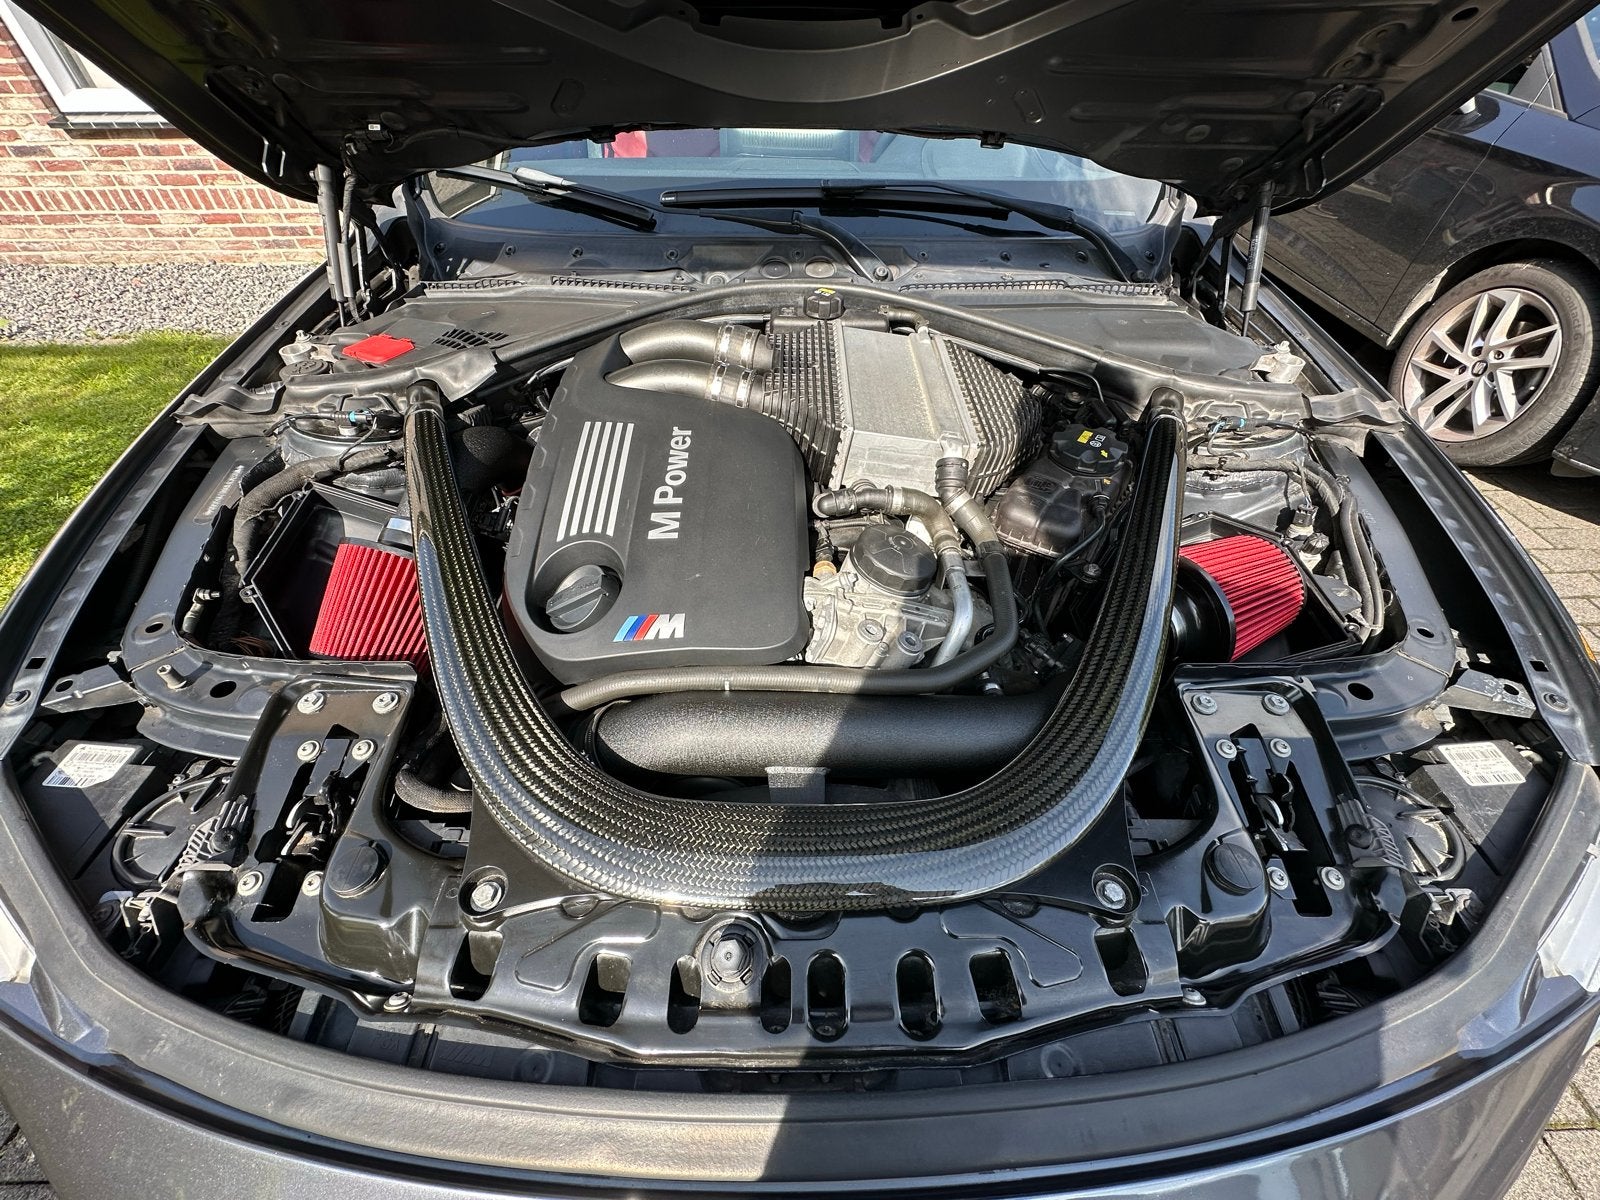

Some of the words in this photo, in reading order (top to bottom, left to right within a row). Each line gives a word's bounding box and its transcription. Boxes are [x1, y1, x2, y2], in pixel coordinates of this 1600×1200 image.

[653, 426, 692, 504] Power
[647, 511, 681, 539] M
[643, 613, 686, 640] M
